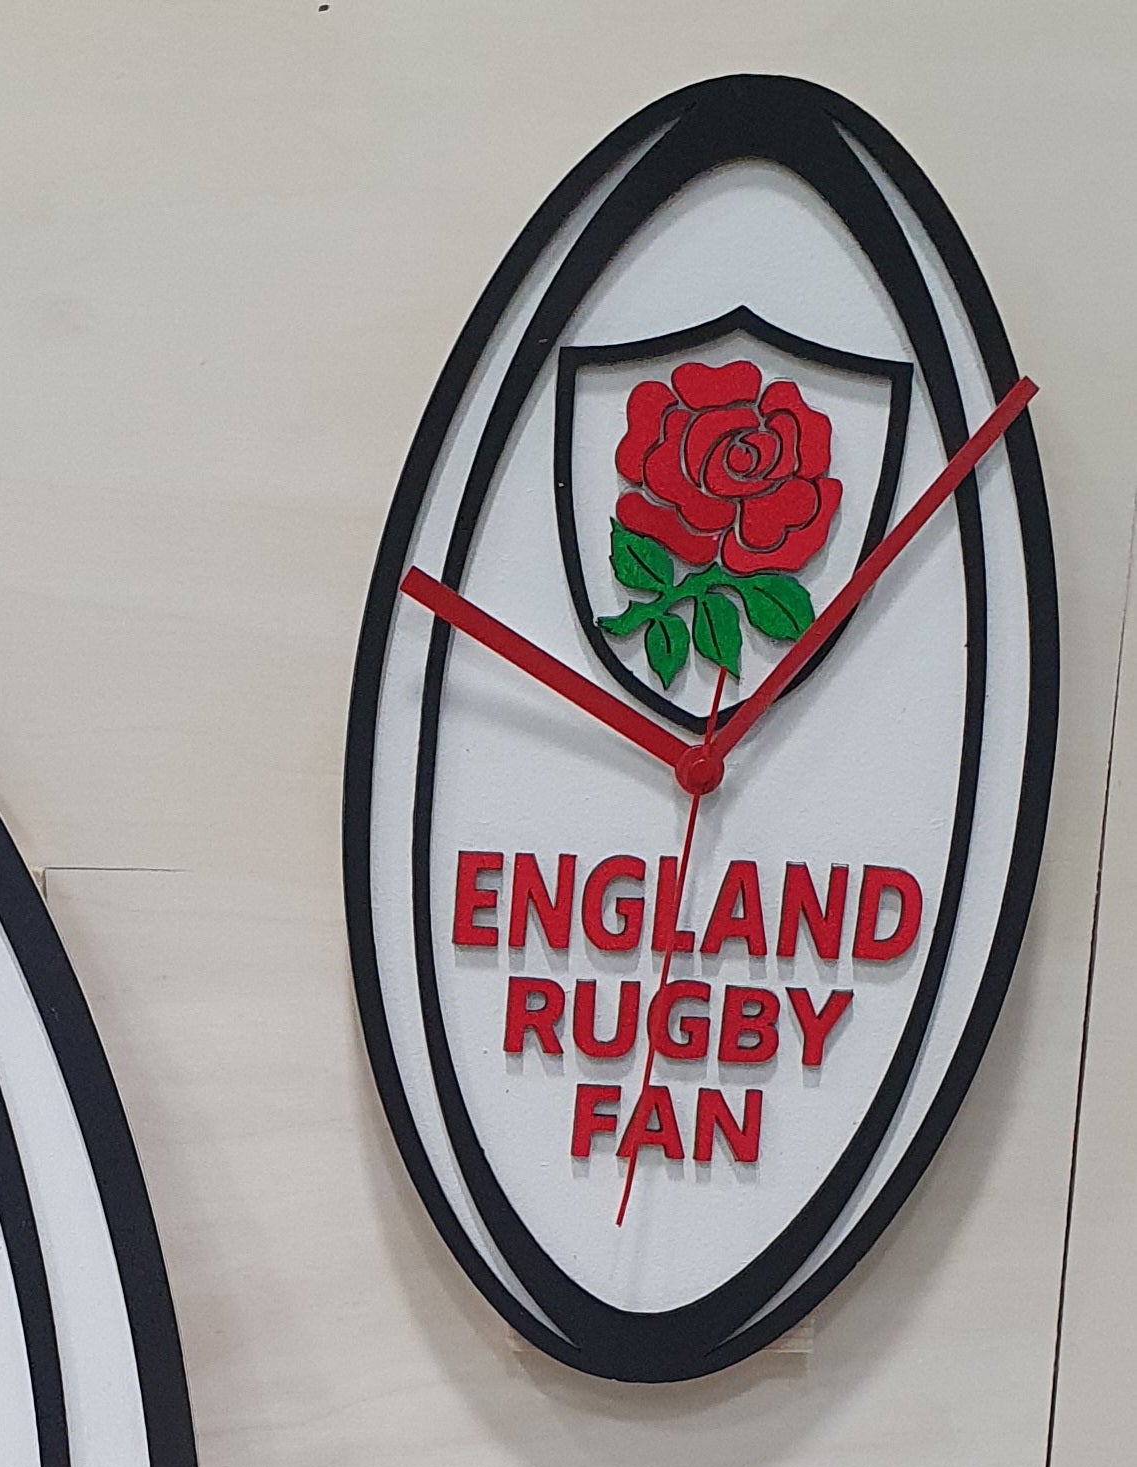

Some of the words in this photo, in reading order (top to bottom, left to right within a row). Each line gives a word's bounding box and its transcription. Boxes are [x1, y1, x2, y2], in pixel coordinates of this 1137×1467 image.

[452, 850, 924, 962] ENGLAND
[503, 976, 854, 1068] RUGBY
[570, 1083, 764, 1164] FAN
